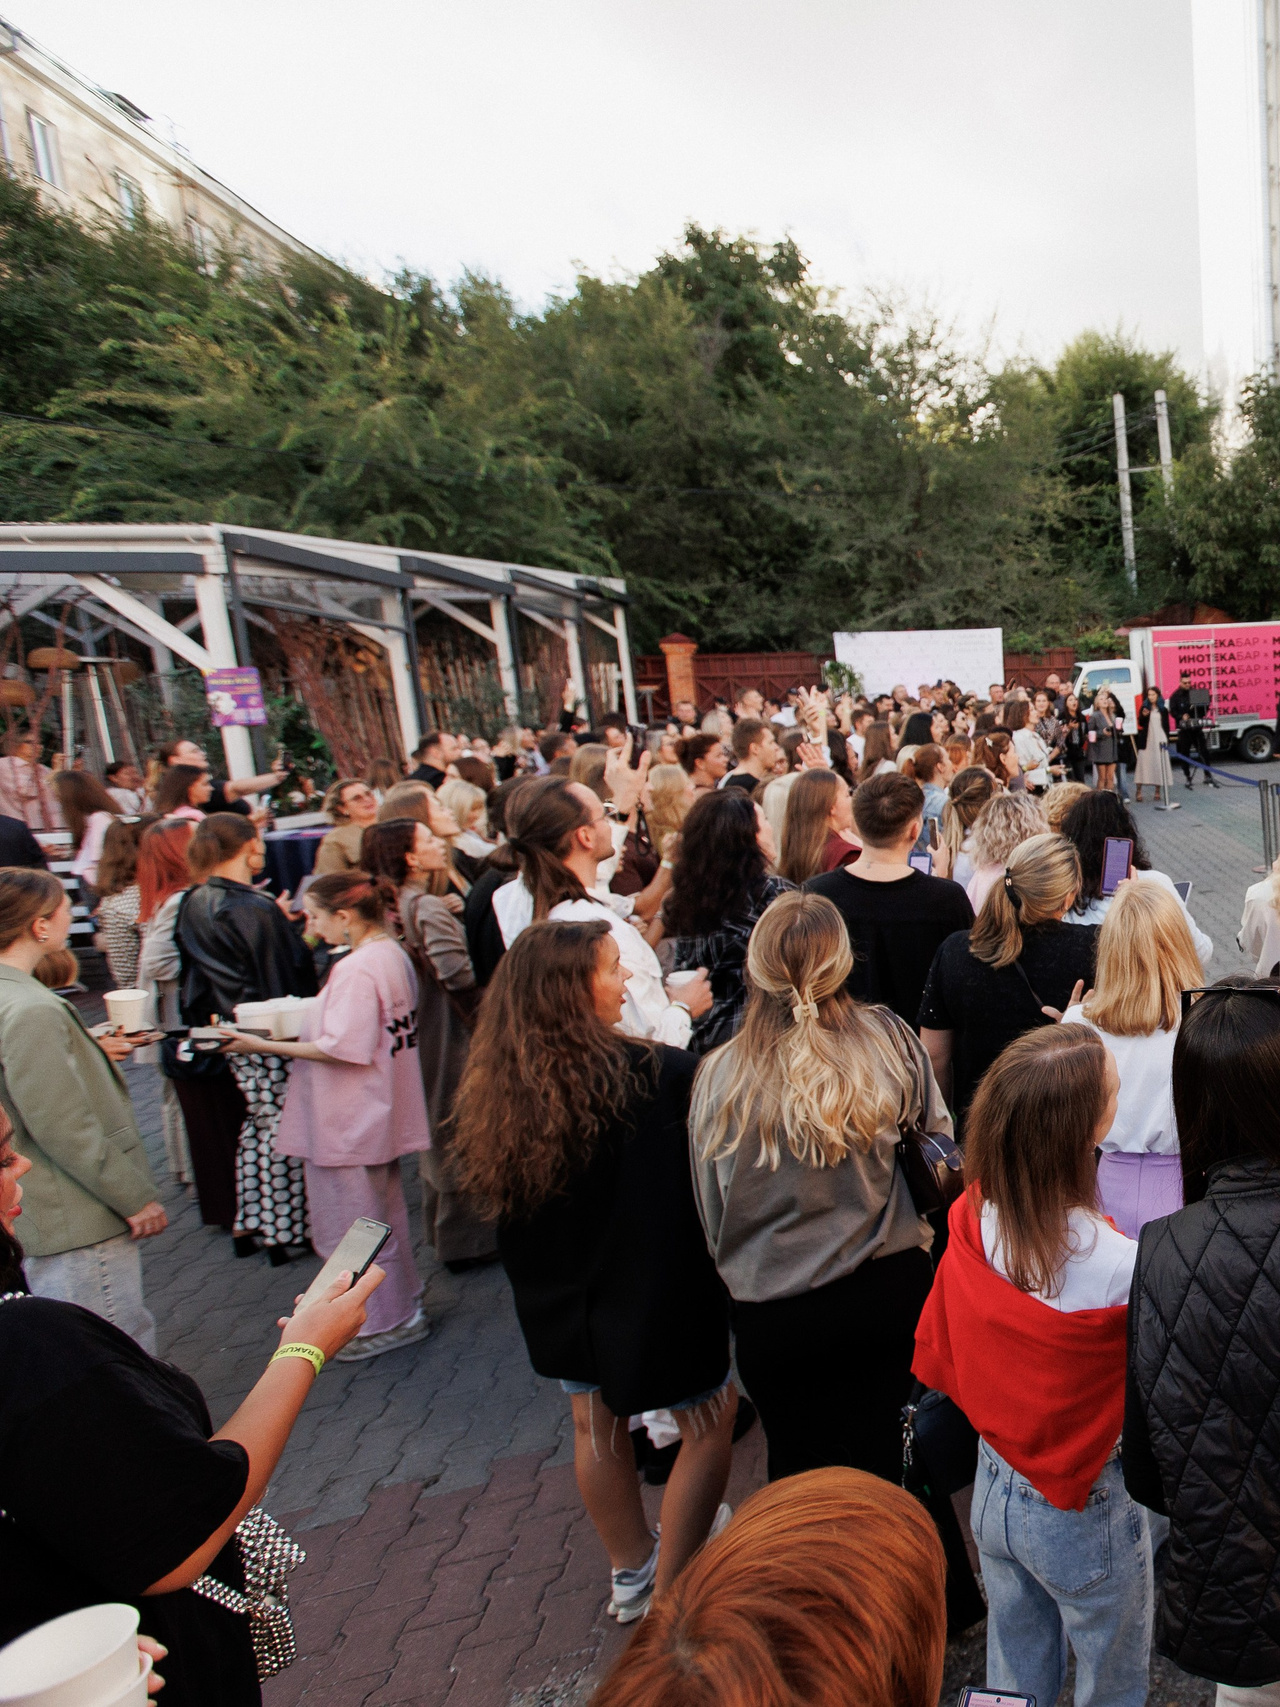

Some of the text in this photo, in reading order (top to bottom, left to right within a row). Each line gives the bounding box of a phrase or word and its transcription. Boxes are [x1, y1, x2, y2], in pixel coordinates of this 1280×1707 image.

[1178, 651, 1260, 664] ИНОТЕКАБАР
[1190, 677, 1262, 690] НОТЕКАБАР
[1208, 704, 1262, 716] ТЕКАБАР
